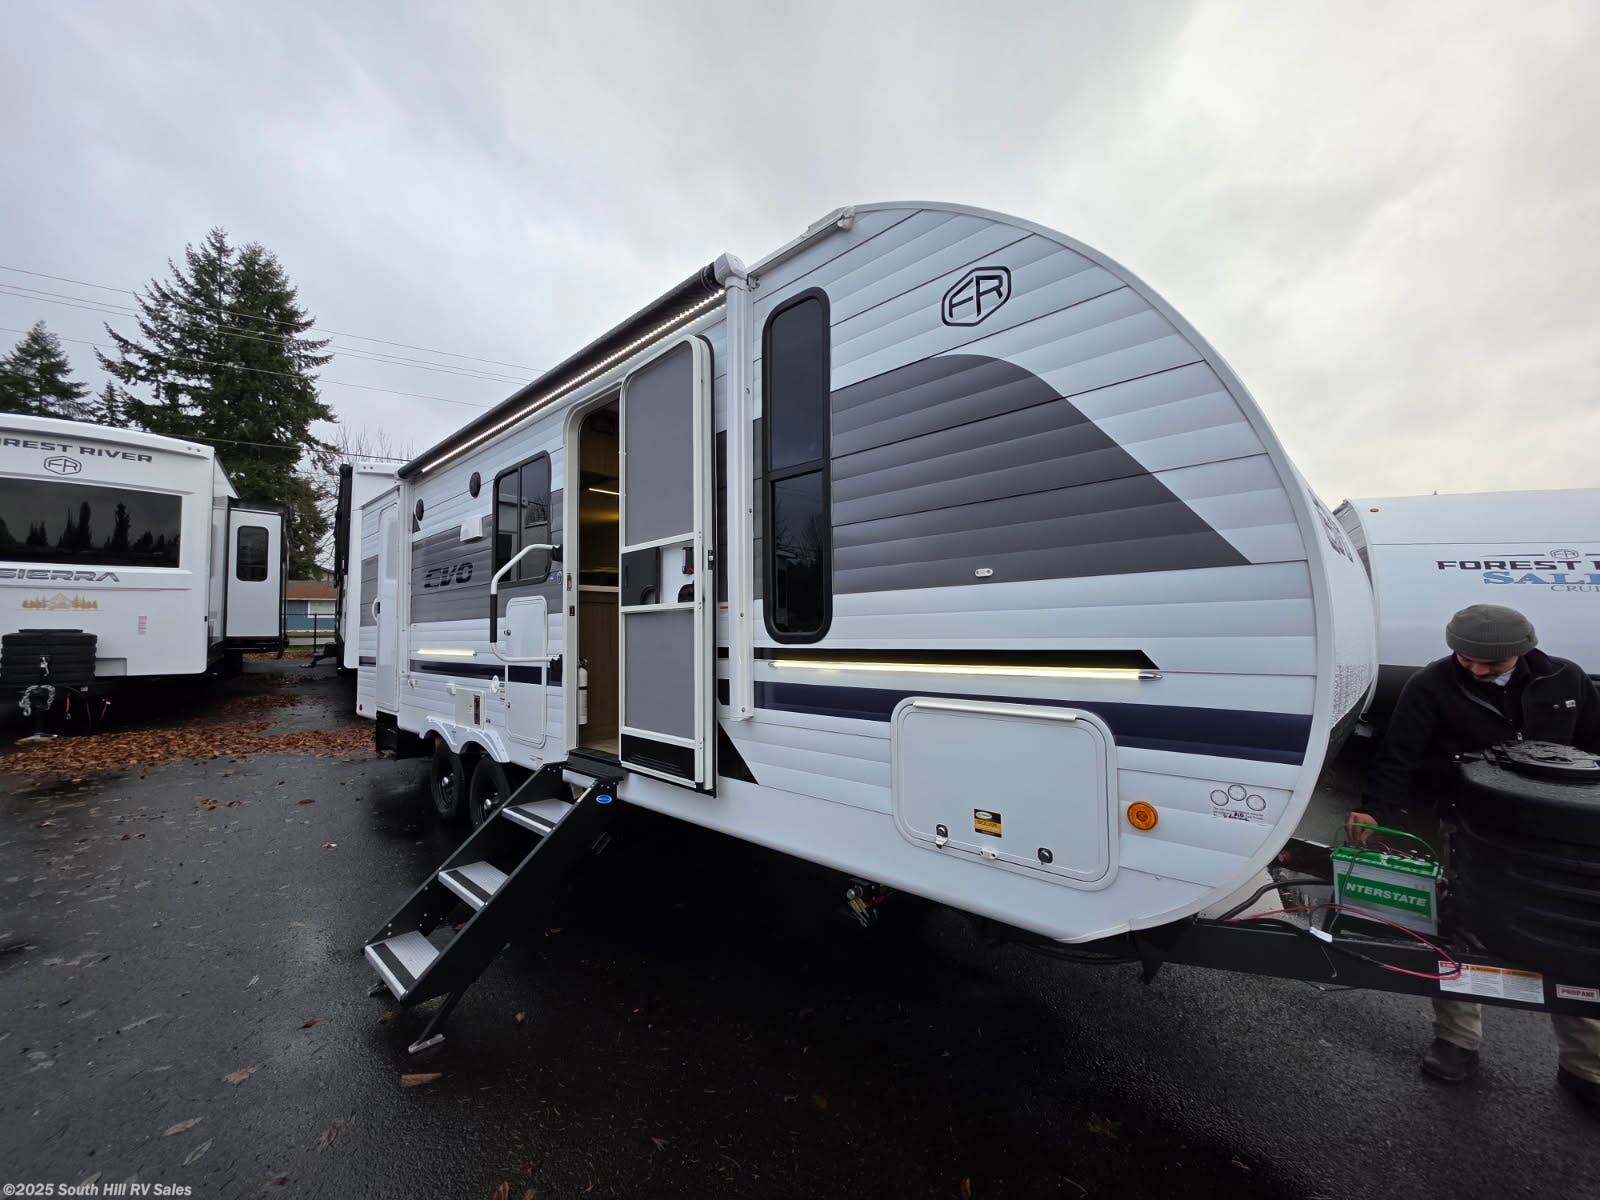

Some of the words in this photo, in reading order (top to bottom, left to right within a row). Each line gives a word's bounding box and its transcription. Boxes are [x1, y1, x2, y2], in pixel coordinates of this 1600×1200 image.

[0, 438, 73, 453] REST
[79, 446, 153, 463] RIVER
[0, 568, 120, 582] SIERRA
[423, 562, 473, 588] EVO
[1435, 560, 1582, 570] FOREST
[1343, 881, 1427, 907] NTERSTATE
